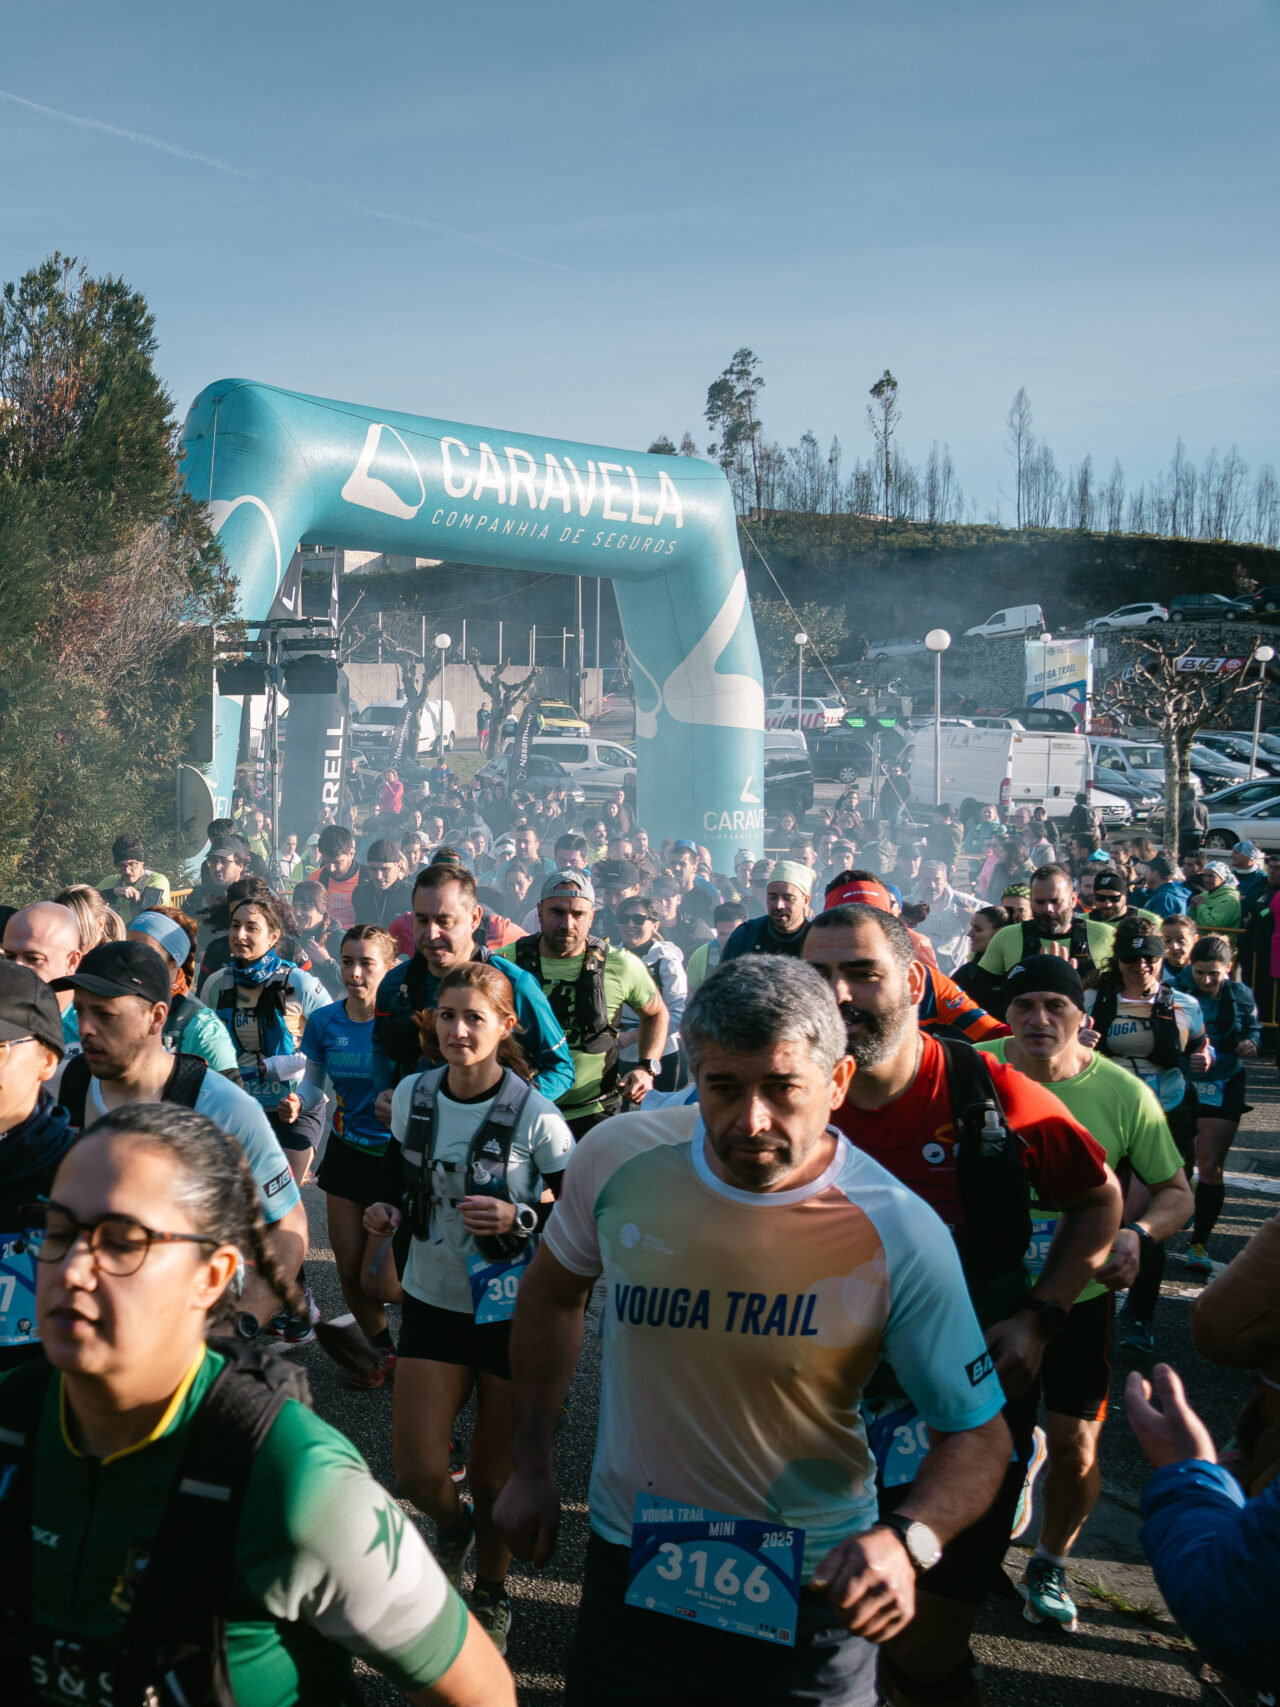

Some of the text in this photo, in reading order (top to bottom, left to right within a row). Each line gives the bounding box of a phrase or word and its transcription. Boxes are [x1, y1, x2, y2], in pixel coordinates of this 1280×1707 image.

[440, 436, 684, 529] CARAVELA
[431, 509, 678, 555] COMPANHIA DE SEGUROS
[1033, 669, 1056, 682] VOGA
[322, 716, 345, 806] RELL
[268, 1169, 290, 1196] BIG
[487, 1275, 519, 1301] 30
[614, 1283, 819, 1337] VOUGA TRAIL
[641, 1507, 705, 1522] VOUGA TRAIL
[708, 1521, 736, 1537] MINI
[761, 1530, 795, 1549] 2025
[655, 1541, 771, 1604] 3166
